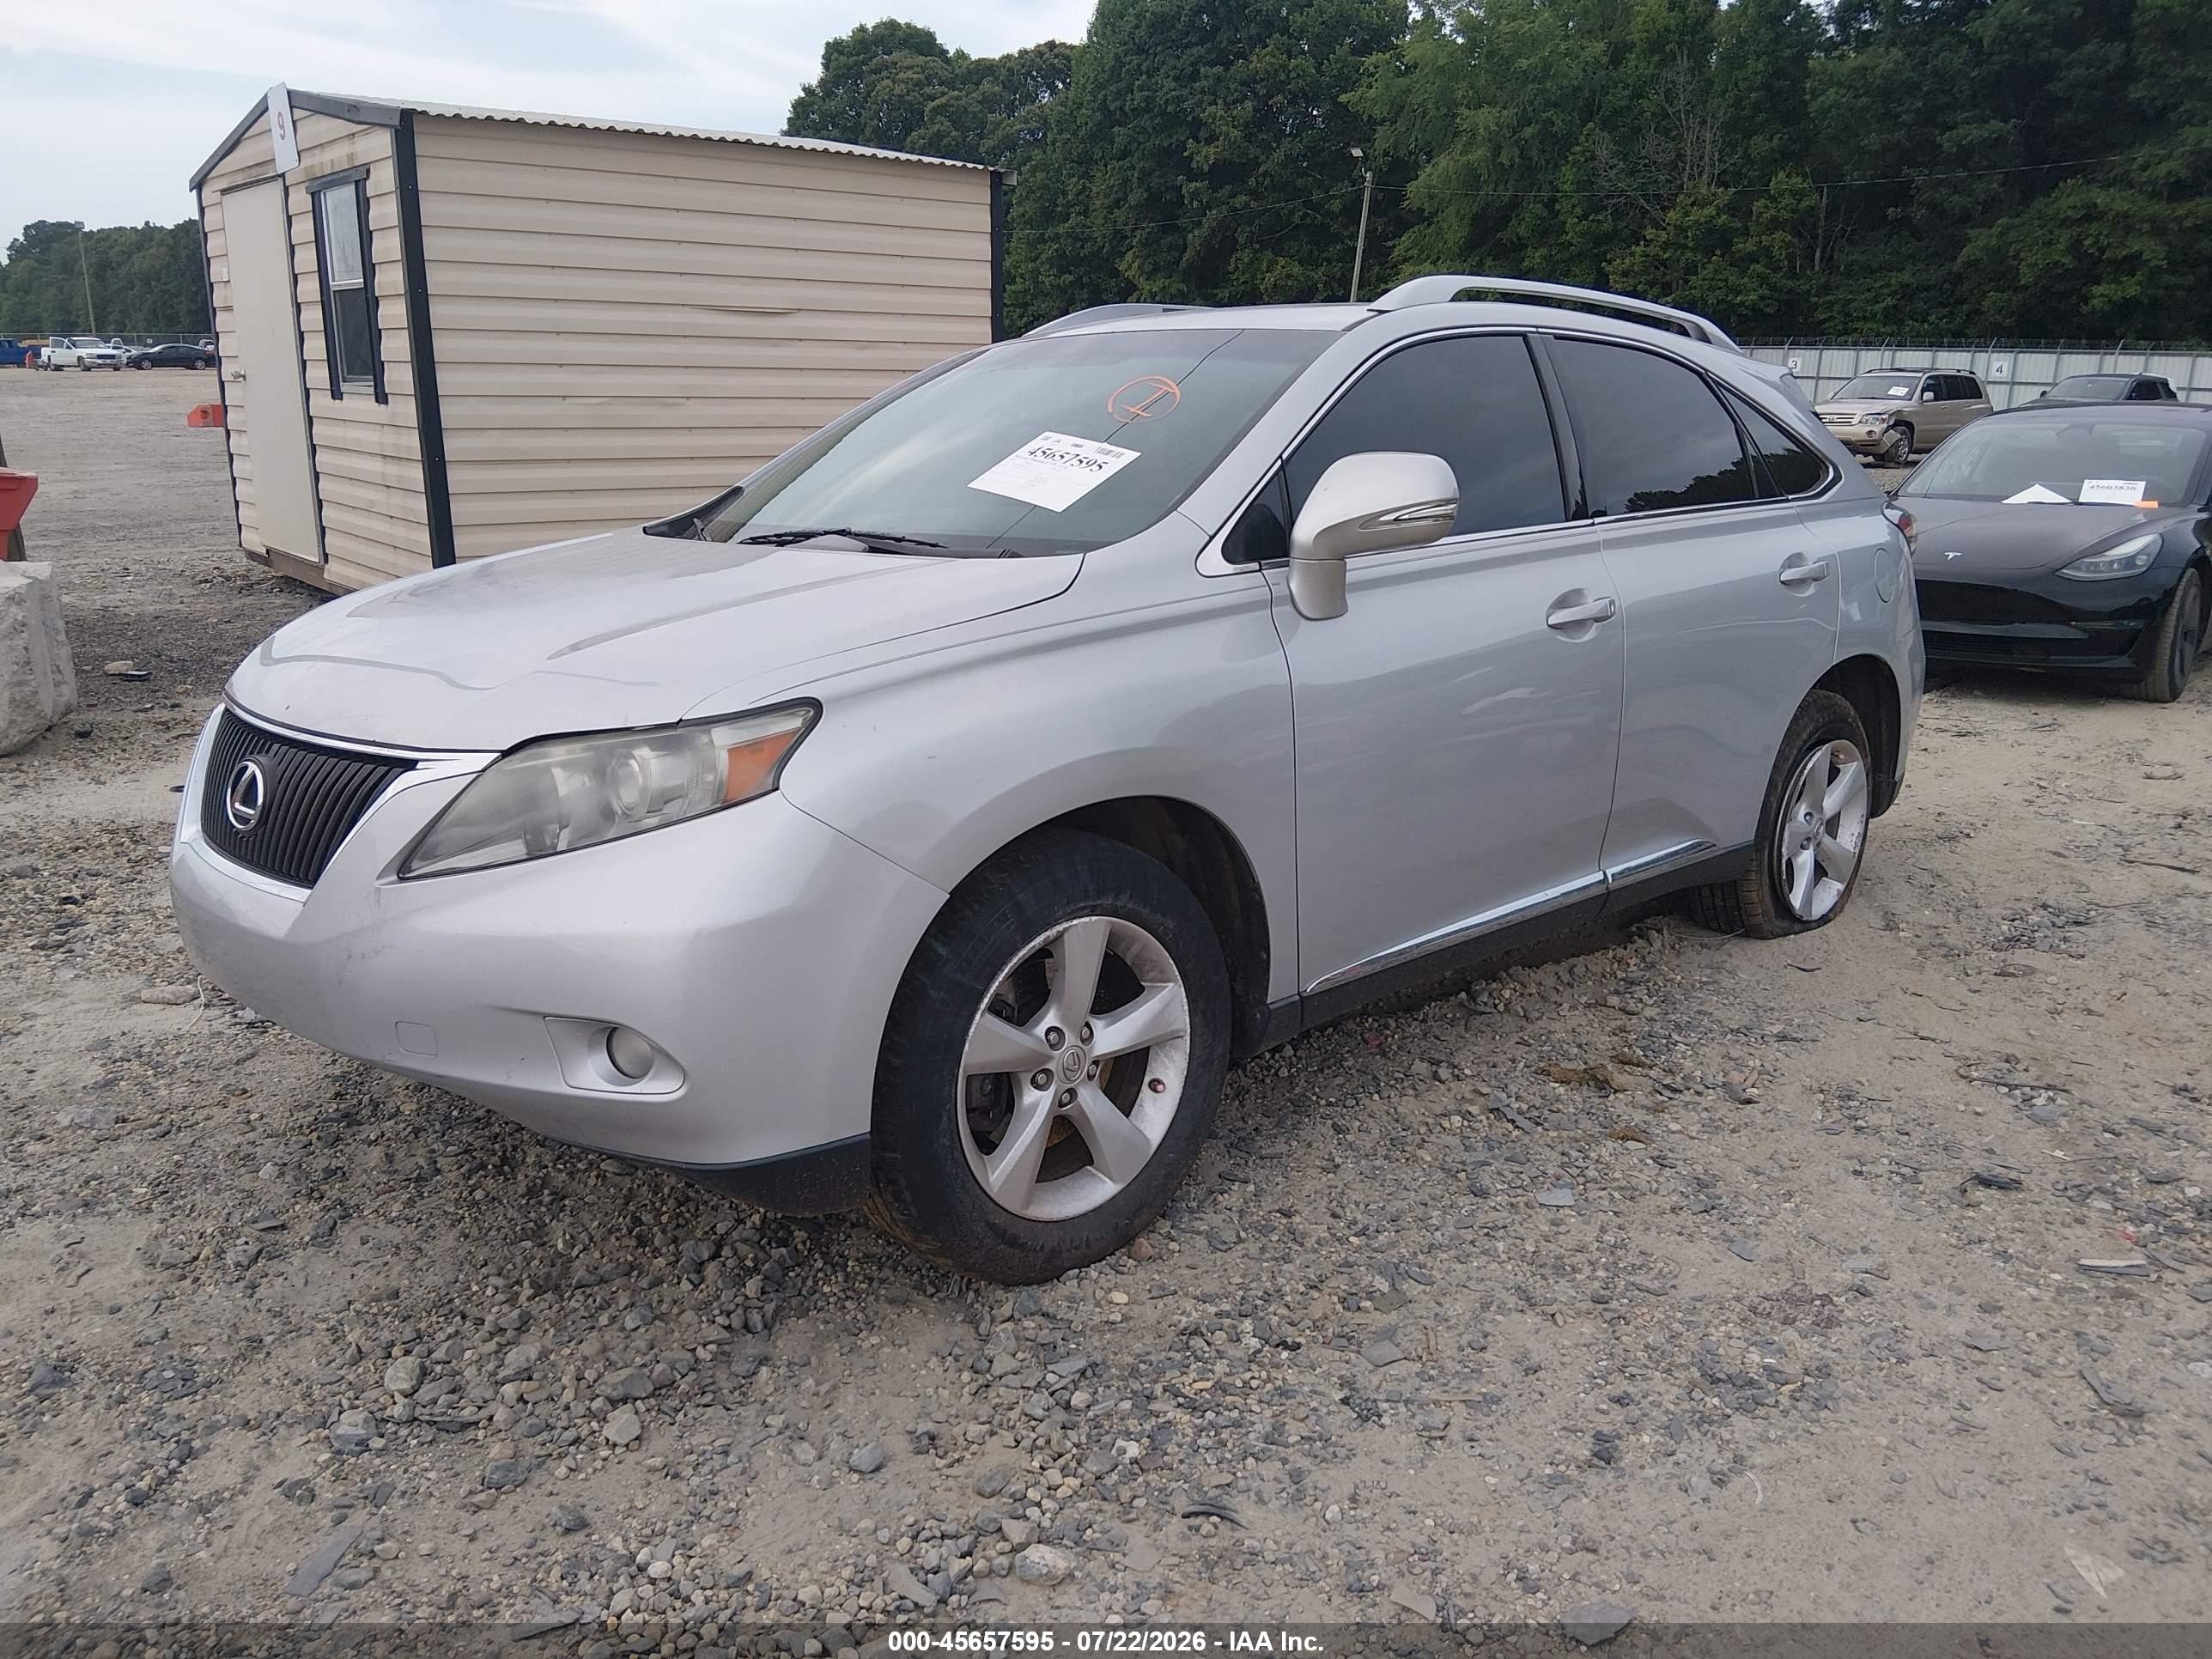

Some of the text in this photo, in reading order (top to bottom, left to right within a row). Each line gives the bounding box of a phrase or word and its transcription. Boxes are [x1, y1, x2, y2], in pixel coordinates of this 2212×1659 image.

[277, 111, 285, 141] 9
[1791, 360, 1798, 370] 3
[1996, 363, 2003, 374] 4
[1026, 446, 1109, 473] 45657595
